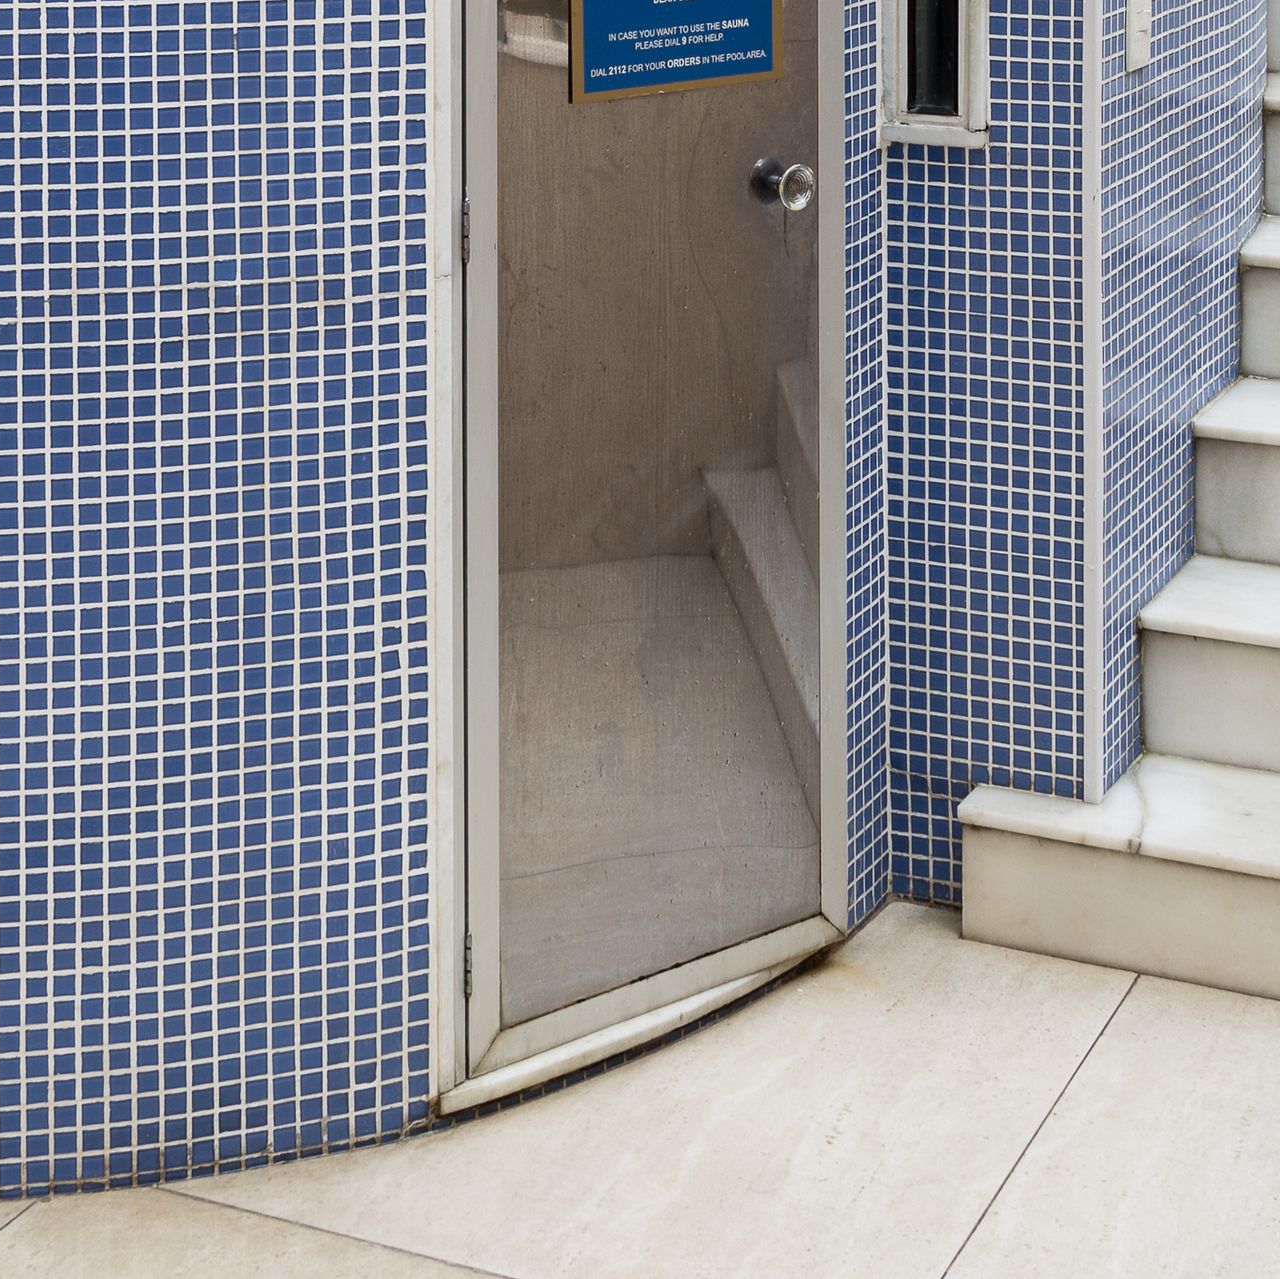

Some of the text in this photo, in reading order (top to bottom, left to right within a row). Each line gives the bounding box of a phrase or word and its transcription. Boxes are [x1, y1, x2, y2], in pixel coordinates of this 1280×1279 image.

[618, 31, 637, 40] CASE
[639, 29, 655, 38] YOU
[656, 26, 677, 36] WANT
[679, 25, 689, 33] TO
[690, 23, 704, 32] USE
[706, 22, 720, 30] THE
[722, 18, 749, 29] SAUNA
[635, 40, 663, 50] PLEASE
[665, 38, 681, 47] DIAL
[682, 36, 687, 45] 9
[688, 35, 703, 44] FOR
[591, 68, 607, 77] DIAL
[609, 65, 626, 75] 2112
[628, 64, 643, 72] FOR
[645, 61, 666, 71] YOUR
[667, 56, 701, 68] ORDERS
[702, 56, 709, 64] IN
[711, 54, 725, 62] THE
[726, 52, 745, 61] POOL
